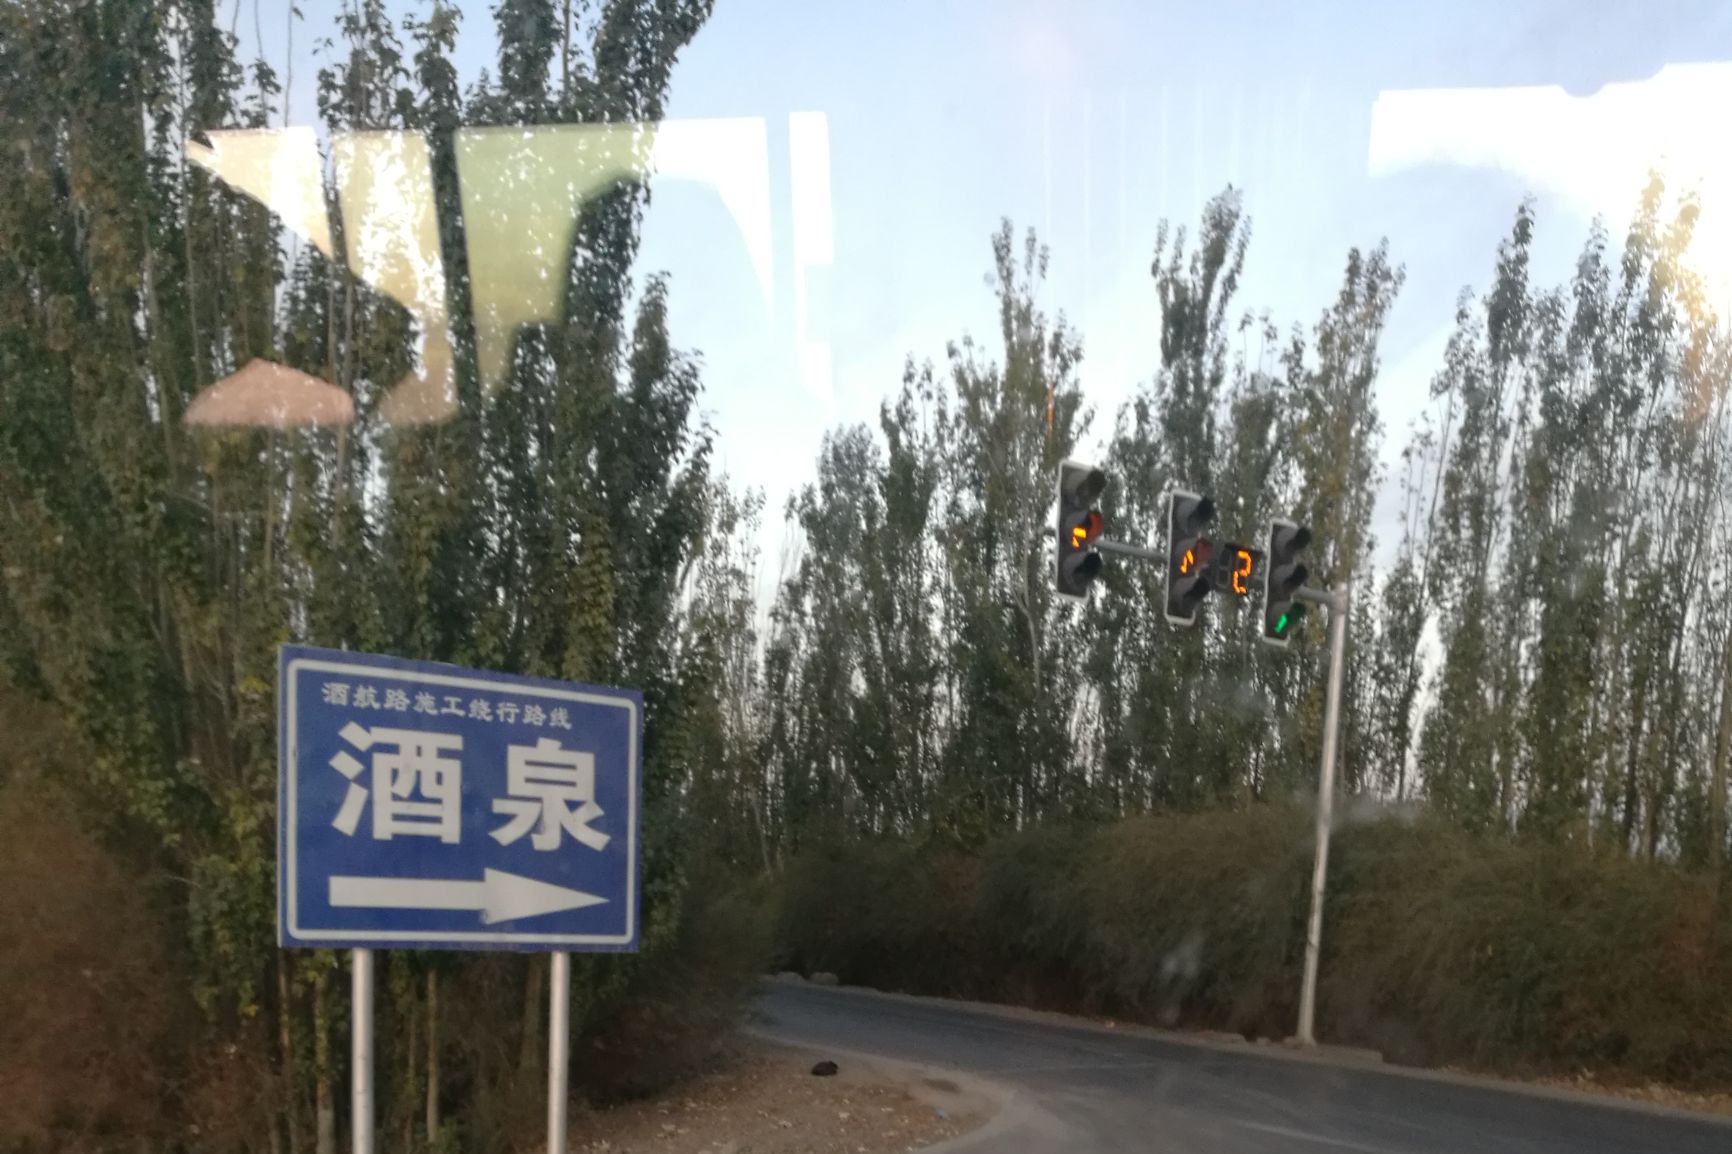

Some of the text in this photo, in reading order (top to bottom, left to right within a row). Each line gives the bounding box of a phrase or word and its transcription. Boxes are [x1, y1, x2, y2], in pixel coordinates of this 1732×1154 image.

[1232, 549, 1252, 593] 2
[321, 682, 572, 729] 酒航路施工绕行路线
[328, 720, 611, 851] 酒泉
